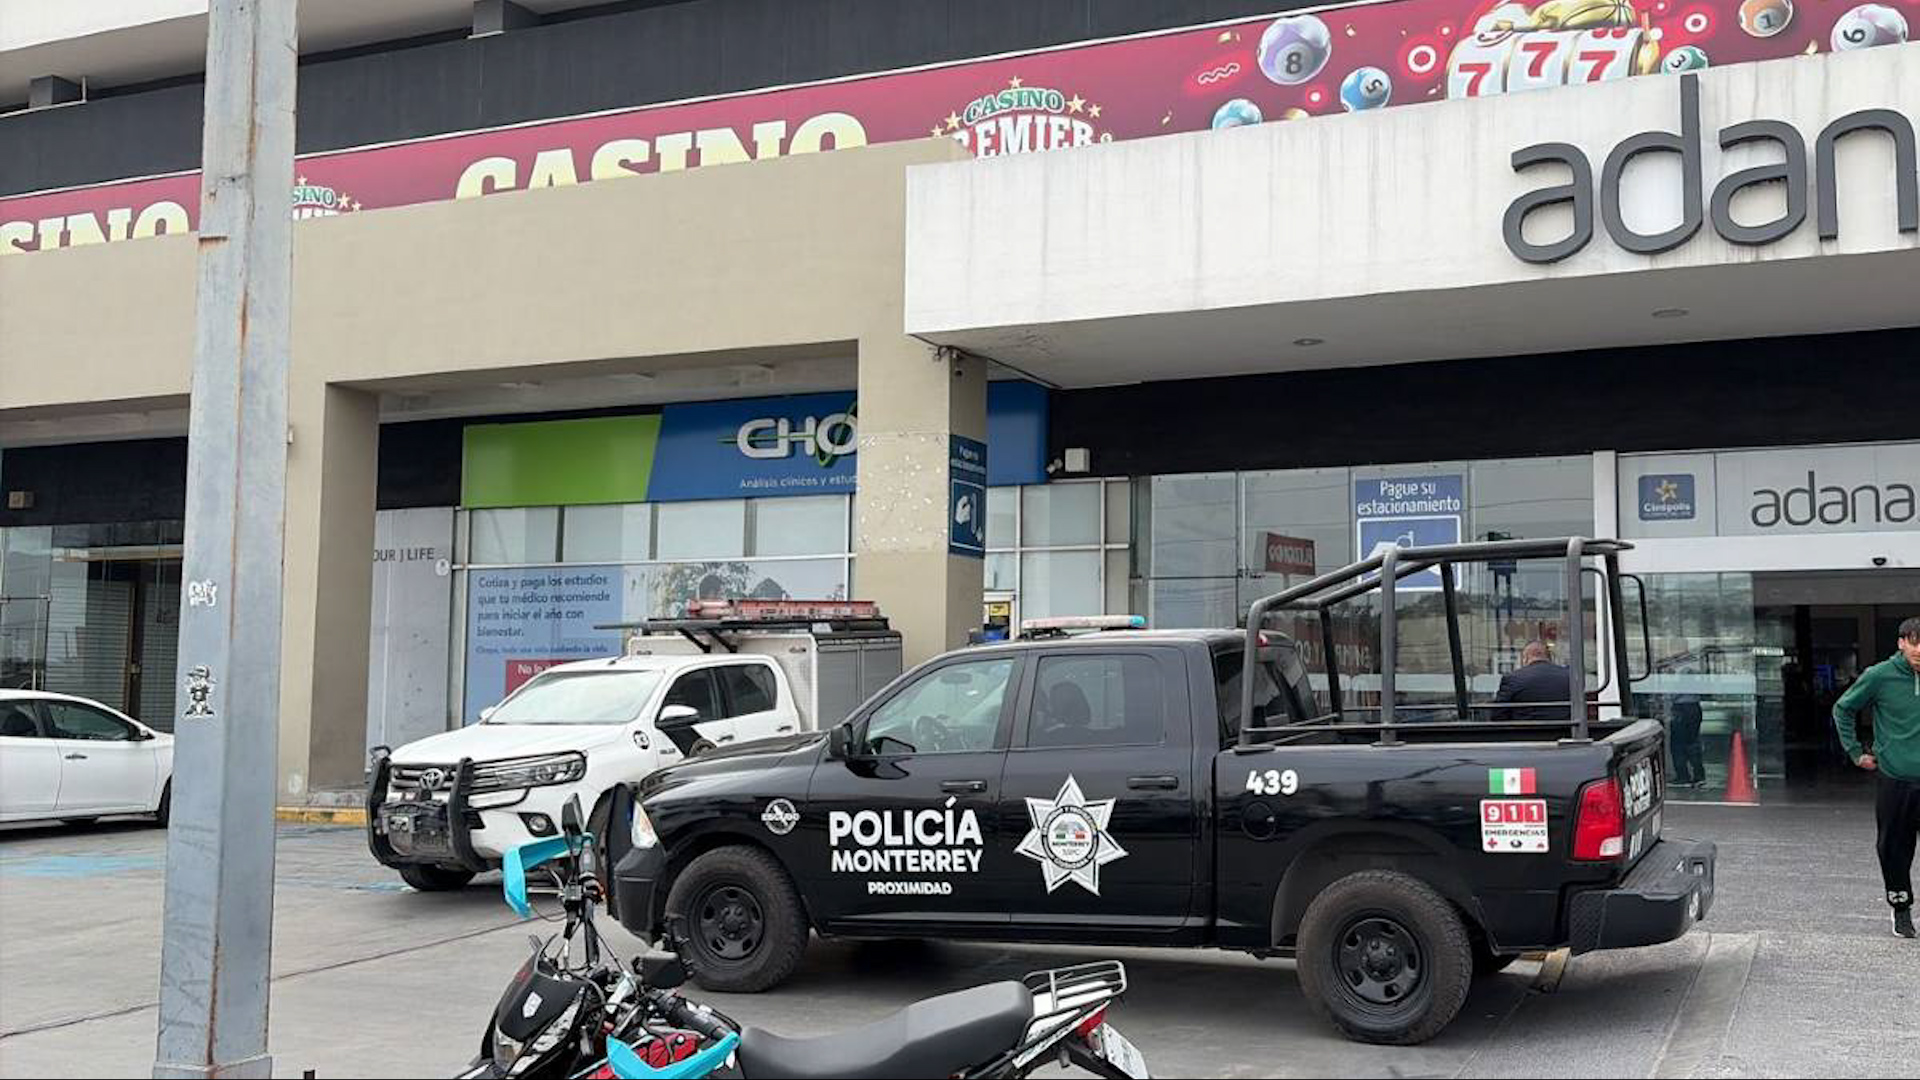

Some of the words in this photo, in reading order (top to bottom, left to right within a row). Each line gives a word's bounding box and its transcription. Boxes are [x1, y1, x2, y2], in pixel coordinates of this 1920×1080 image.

[1286, 51, 1302, 75] 8
[1459, 63, 1491, 97] 7
[1522, 42, 1559, 77] 7
[1578, 51, 1616, 82] 7
[965, 88, 1063, 124] CASINO
[1503, 75, 1919, 265] adan
[1380, 481, 1418, 499] Pague
[1422, 481, 1436, 494] su
[1751, 470, 1915, 527] adana
[1358, 496, 1460, 515] estacionamiento
[407, 548, 435, 560] LIFE
[478, 577, 509, 588] Cotiza
[520, 578, 546, 590] paga
[548, 574, 562, 586] los
[564, 573, 608, 585] estudios
[511, 590, 548, 603] médico
[544, 607, 562, 619] año
[565, 610, 585, 619] con
[518, 664, 532, 675] No
[1246, 770, 1298, 795] 439
[829, 795, 983, 846] POLICÍA
[1487, 805, 1539, 821] 911
[831, 849, 983, 873] MONTERREY
[868, 881, 952, 895] PROXIMIDAD
